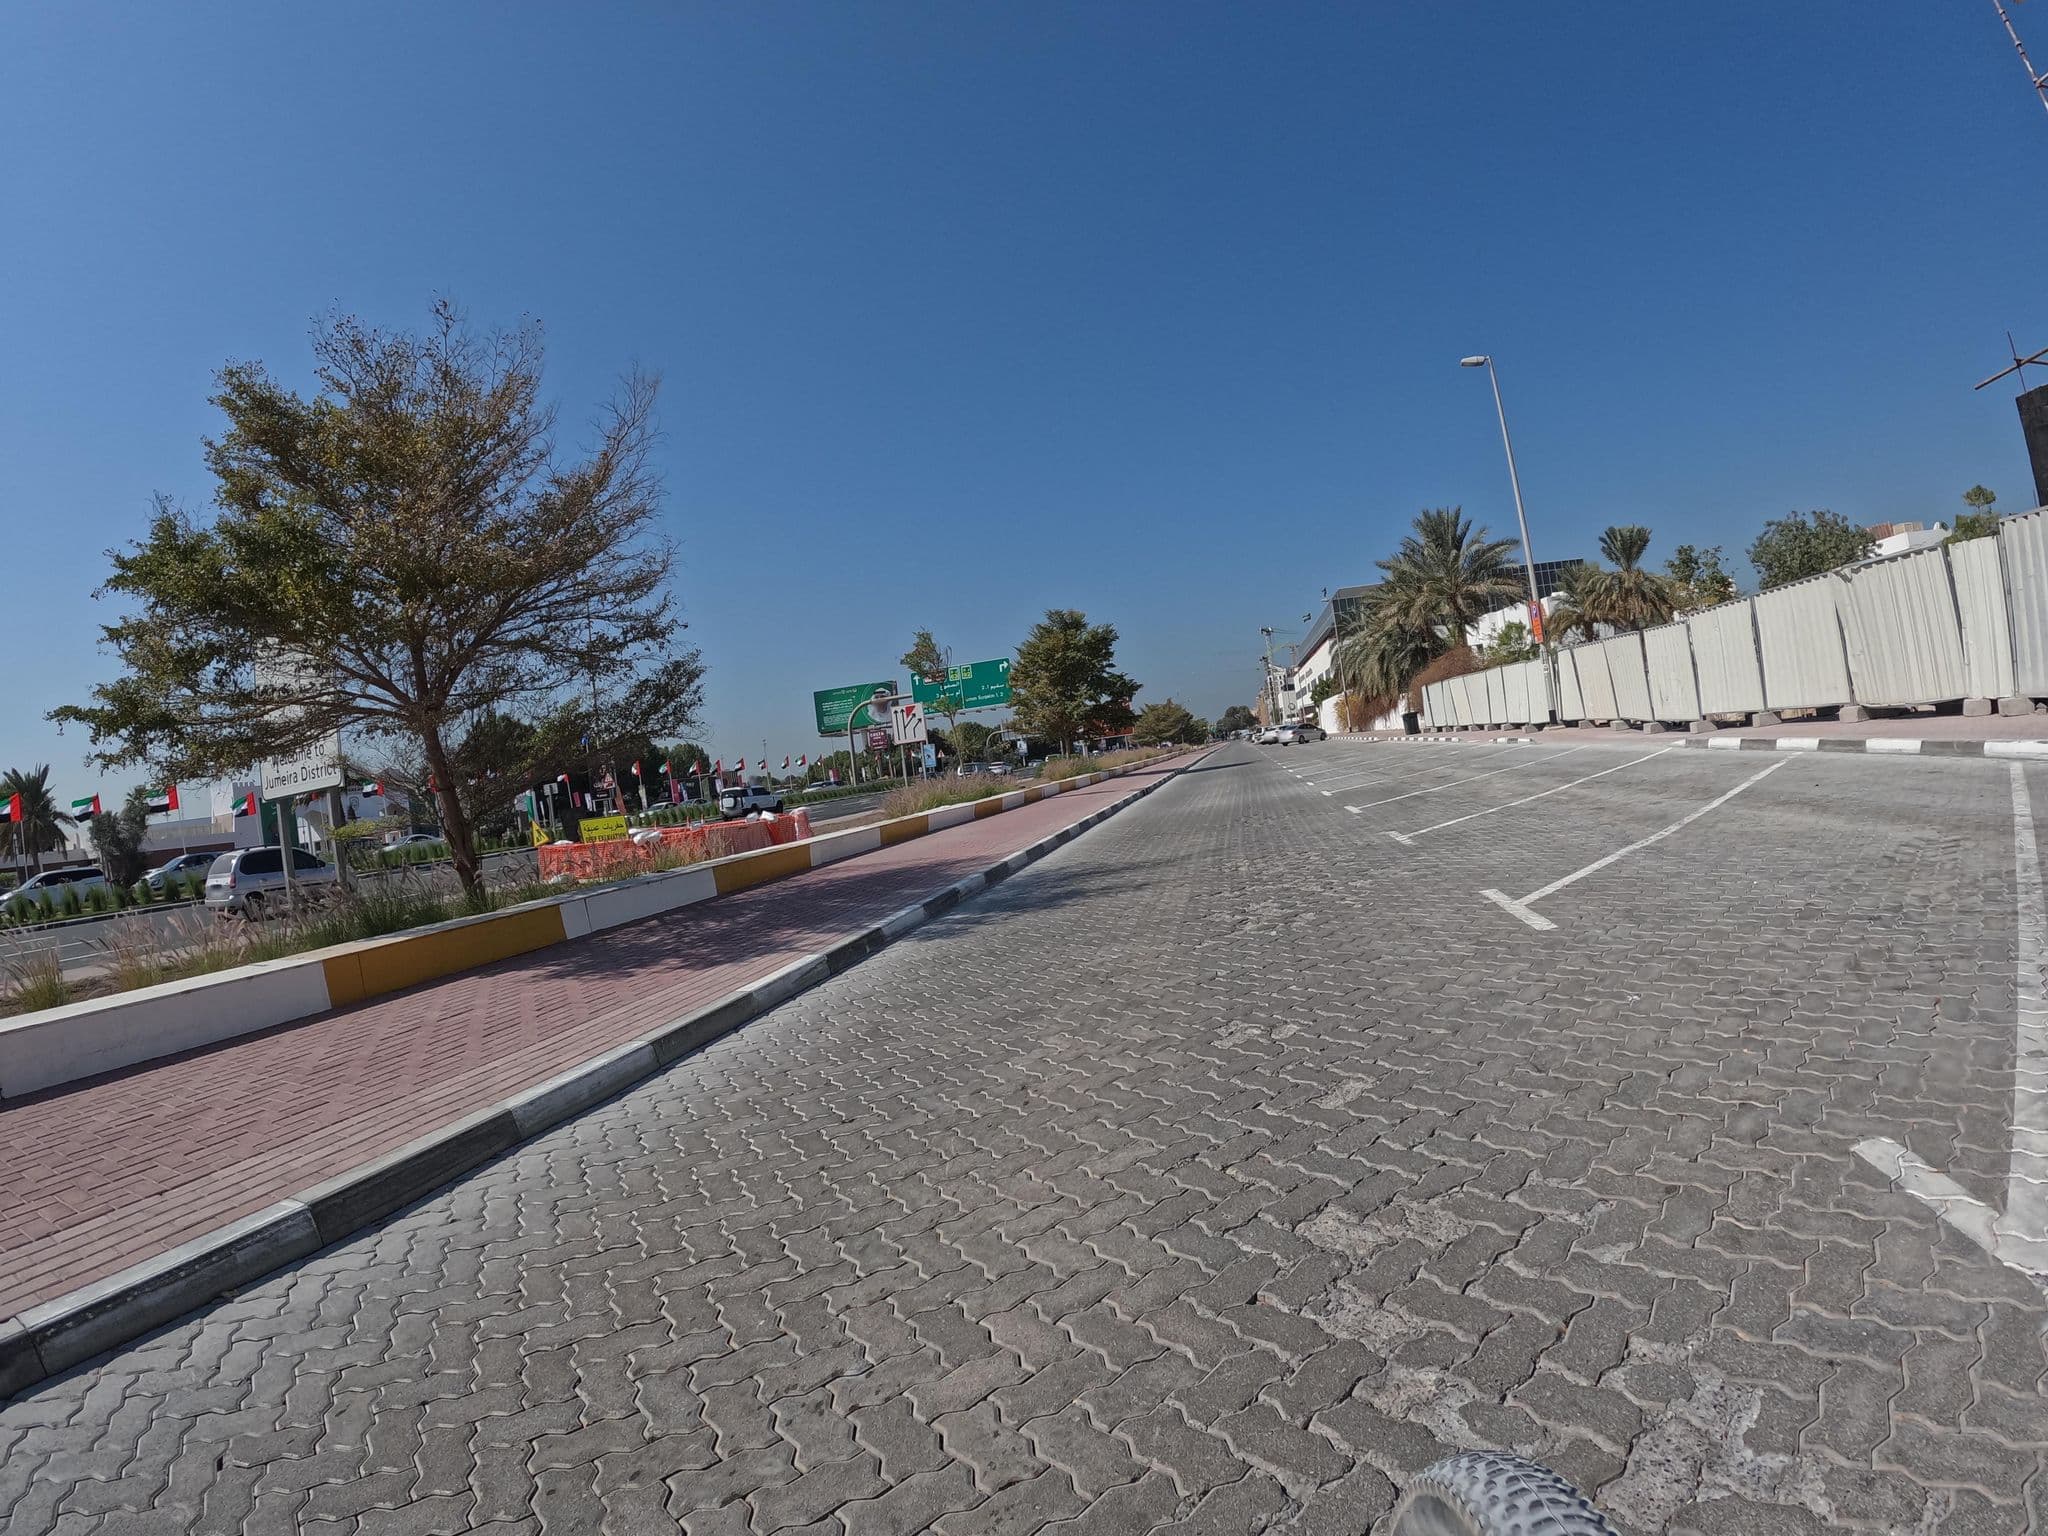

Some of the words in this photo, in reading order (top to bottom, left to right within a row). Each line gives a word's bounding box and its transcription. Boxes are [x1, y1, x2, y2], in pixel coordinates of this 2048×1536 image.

[314, 742, 325, 757] to
[265, 770, 298, 790] Jumeira
[301, 761, 338, 781] District
